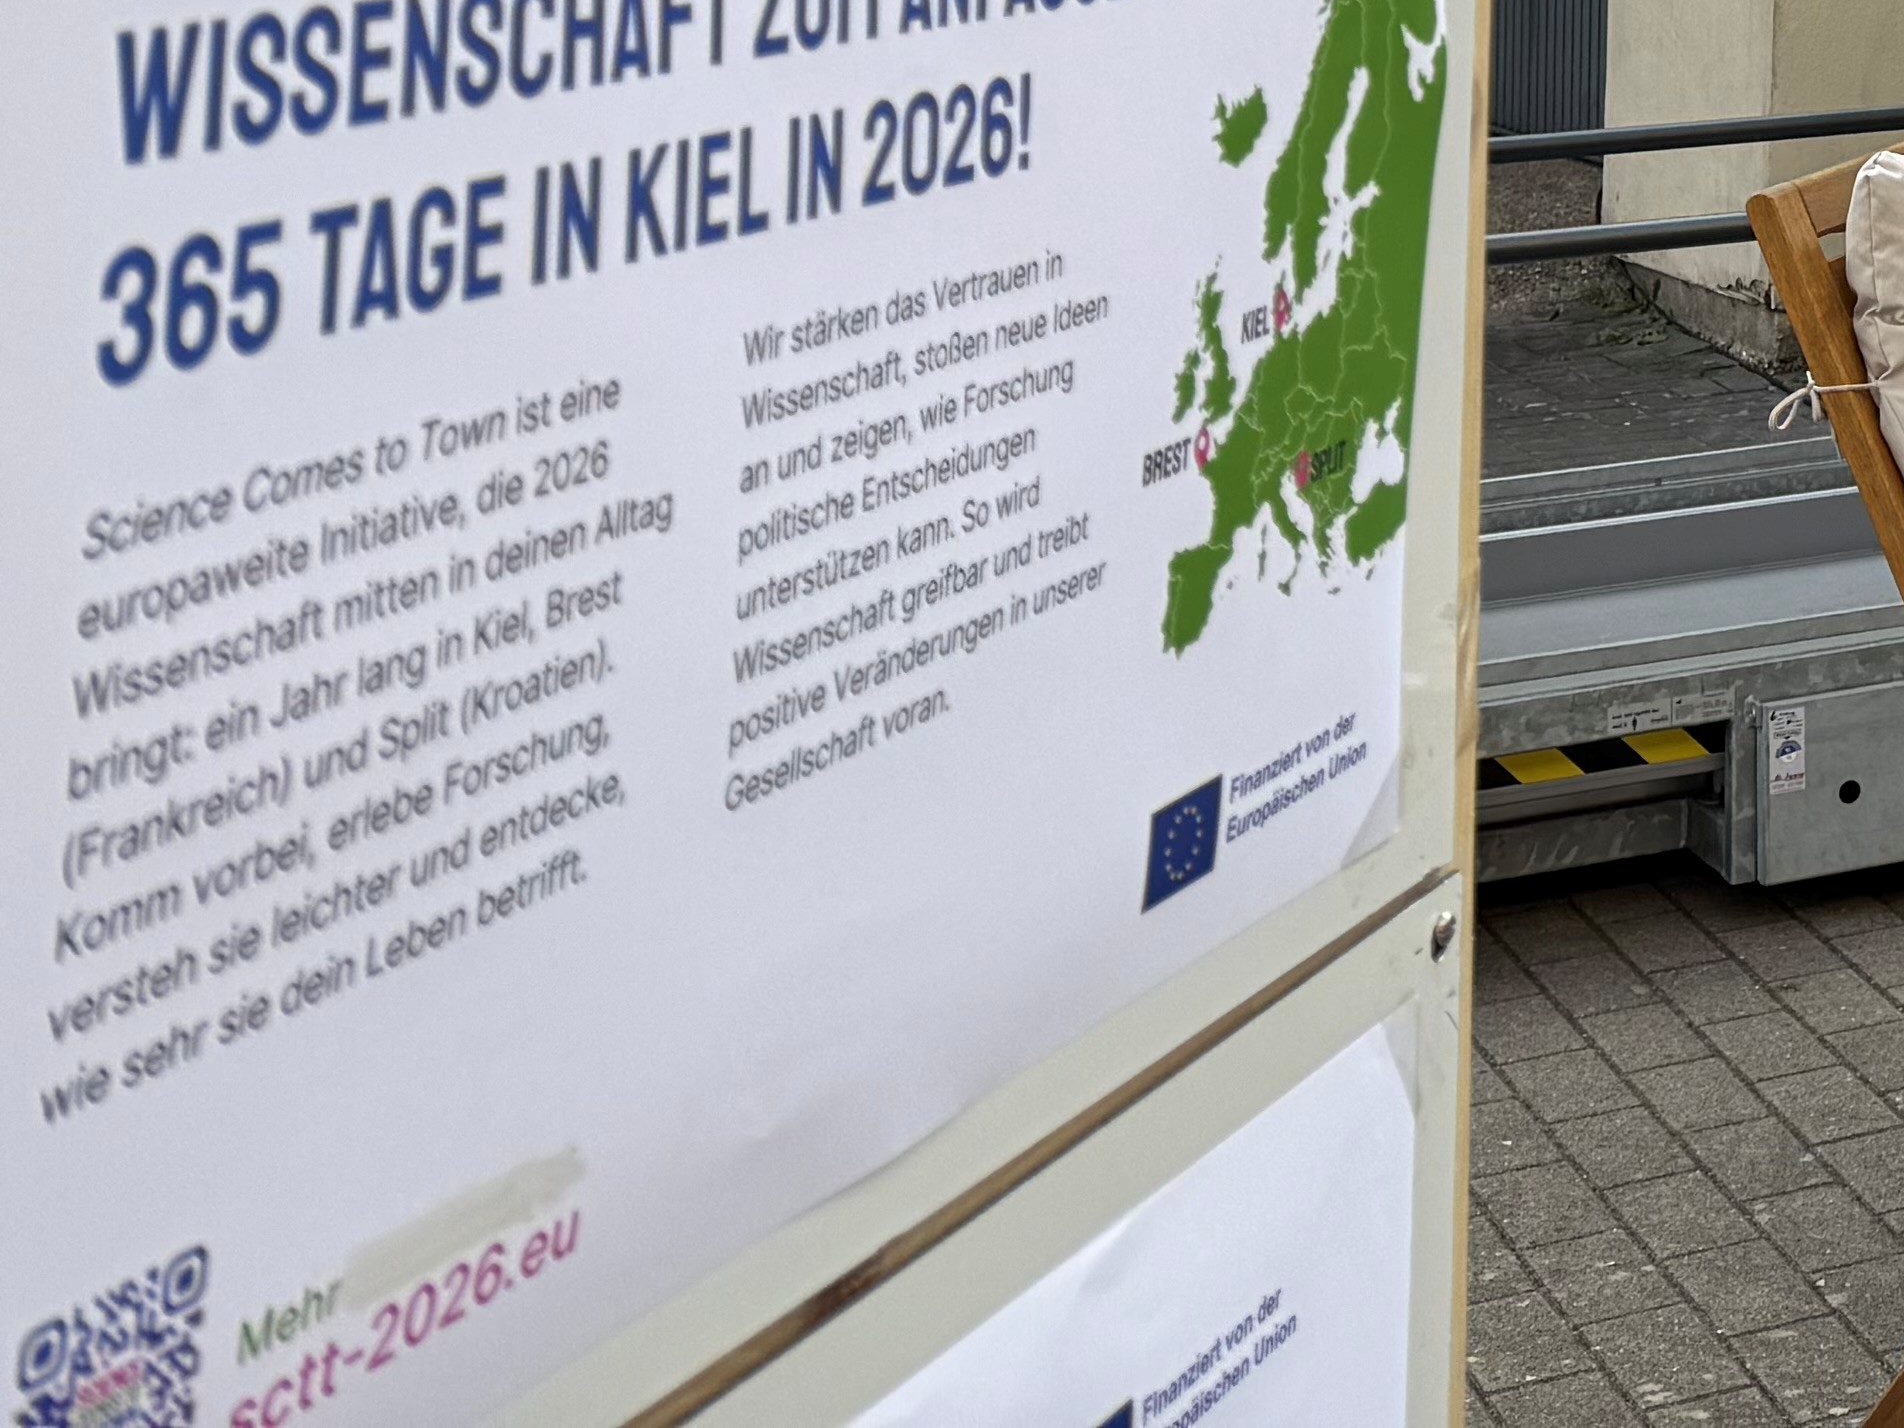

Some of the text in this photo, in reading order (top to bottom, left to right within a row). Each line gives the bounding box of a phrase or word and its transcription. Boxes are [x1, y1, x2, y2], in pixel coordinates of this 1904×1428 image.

[96, 73, 1033, 388] 365 TAGE IN KIEL IN 2026!
[743, 248, 1063, 367] Wir stärken das Vertrauen in
[740, 295, 1110, 430] Wissenschaft, stoßen neue Ideen
[1241, 305, 1270, 344] KIEL
[81, 378, 622, 563] Science Comes to Town ist eine
[737, 428, 1036, 567] politische Entscheidungen
[739, 359, 1075, 495] an und zeigen, wie Forschung
[1143, 438, 1191, 488] BREST
[71, 492, 674, 720] Wissenschaft mitten in deinen Alltag
[77, 438, 611, 642] europaweite Initiative, die 2026
[732, 512, 1091, 684] Wissenschaft greifbar und treibt
[736, 475, 1041, 622] unterstützen kann. So wird
[67, 570, 623, 802] bringt: ein Jahr lang in Kiel, Brest
[727, 561, 1107, 760] positive Veränderungen in unserer
[62, 637, 615, 891] (Frankreich) und Split (Kroatien).
[723, 689, 951, 812] Gesellschaft voran.
[1226, 742, 1367, 843] Europäischen Union
[1230, 712, 1356, 804] Finanziert von der
[47, 774, 626, 1045] versteh sie leichter und entdecke,
[54, 713, 611, 965] Komm vorbei, erlebe Forschung,
[40, 849, 588, 1126] wie sehr sie dein Leben betrifft.
[230, 1210, 581, 1428] sctt-2026.eu
[236, 1279, 343, 1366] Mehr
